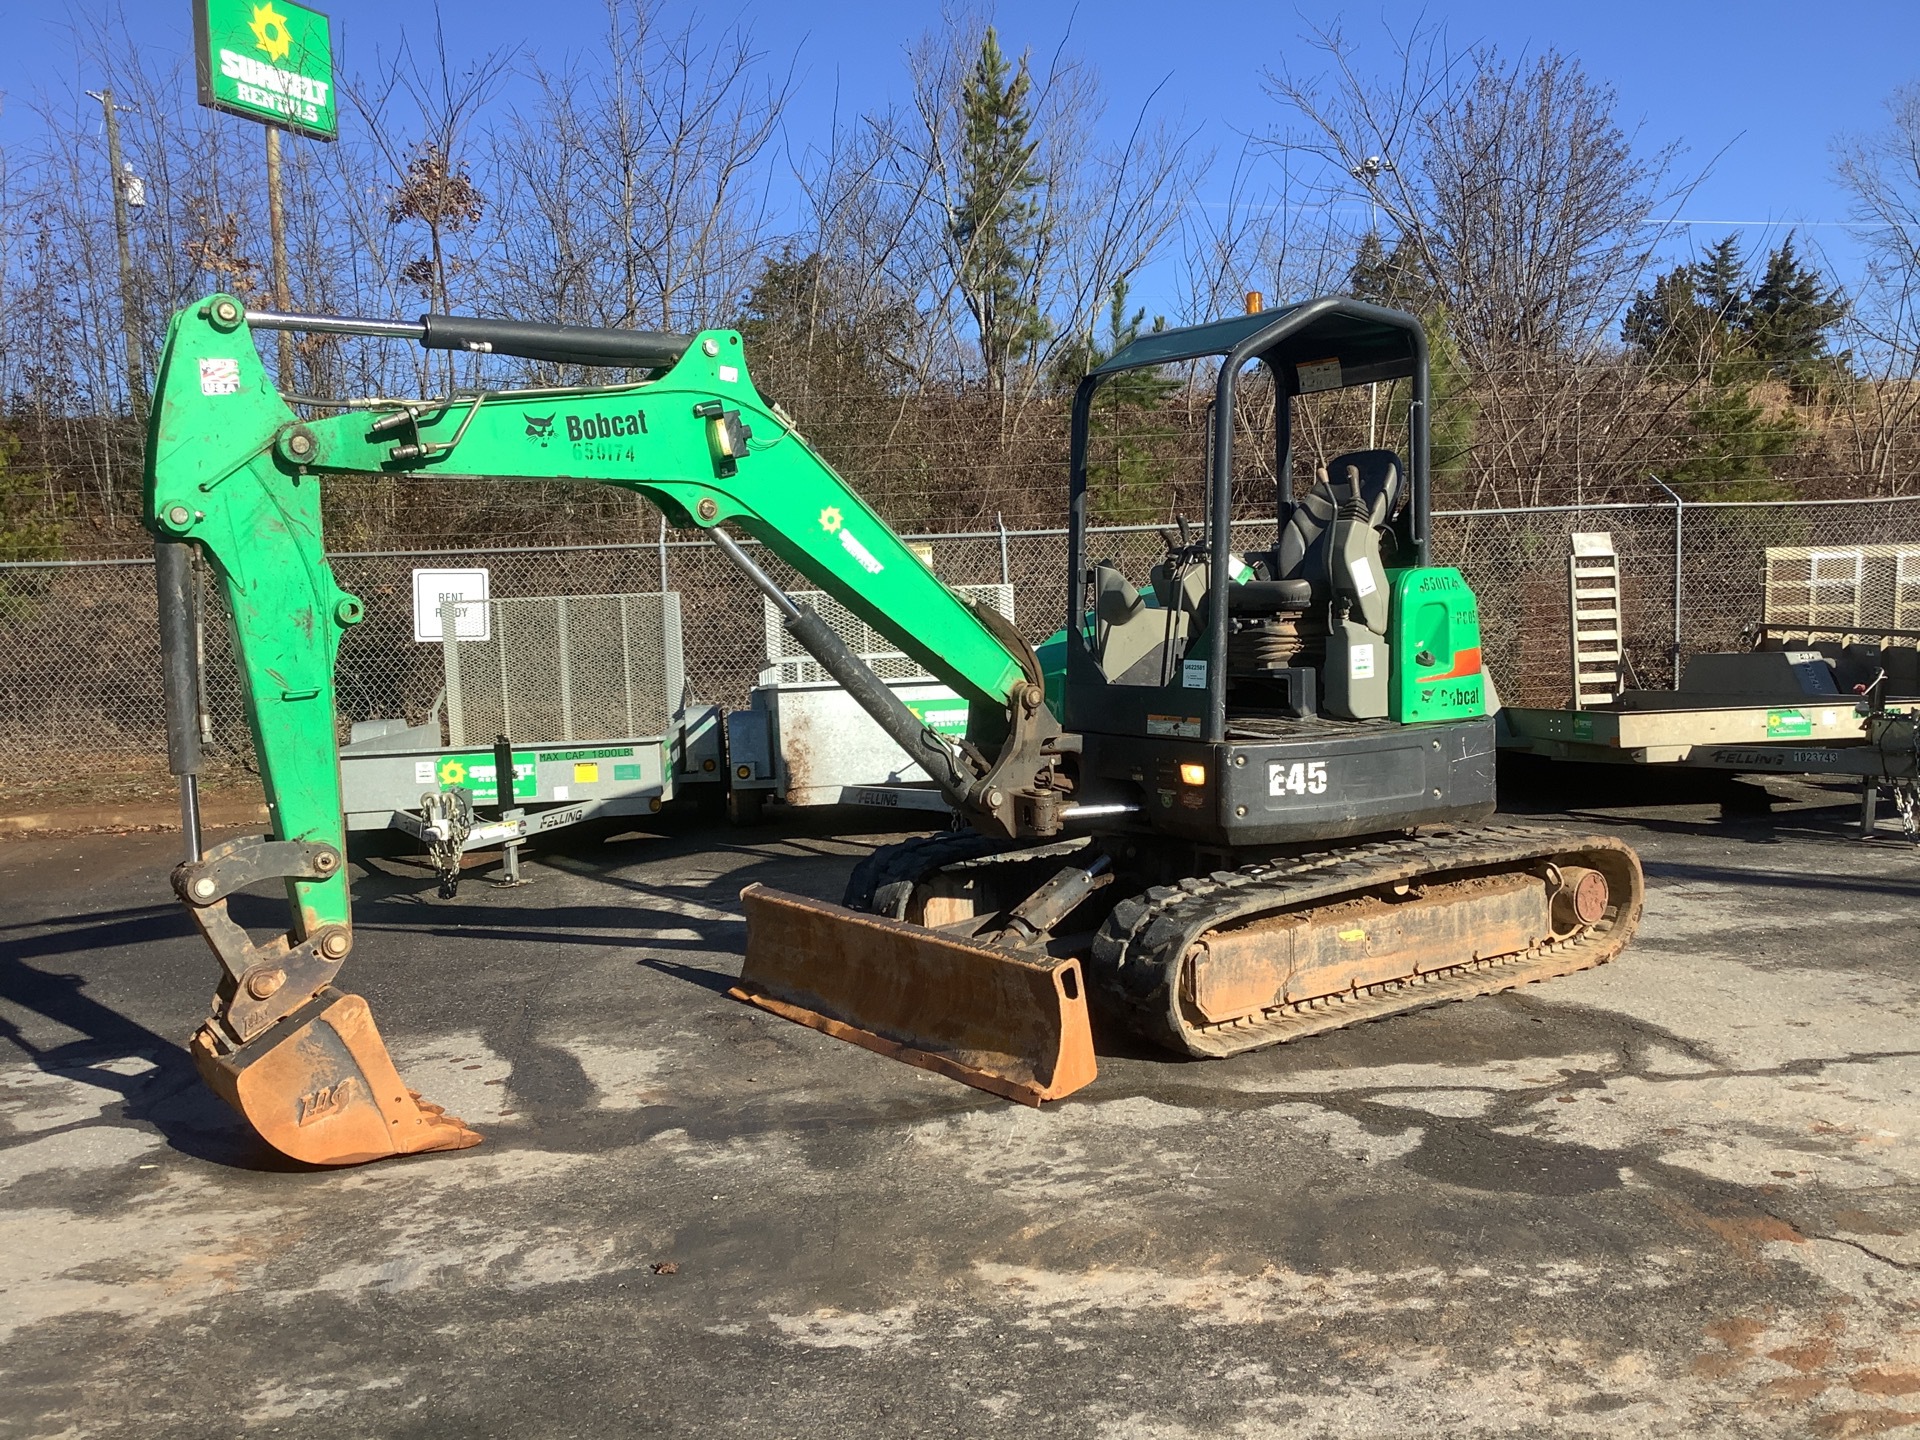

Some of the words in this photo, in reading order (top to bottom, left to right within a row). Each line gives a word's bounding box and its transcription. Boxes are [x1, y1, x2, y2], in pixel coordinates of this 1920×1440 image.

[566, 409, 648, 441] Bobcat
[438, 592, 464, 602] RENT
[435, 607, 468, 617] RDY
[539, 753, 559, 762] MAX
[565, 751, 585, 760] CAP
[1795, 752, 1837, 763] 1023743
[1269, 761, 1328, 797] E45
